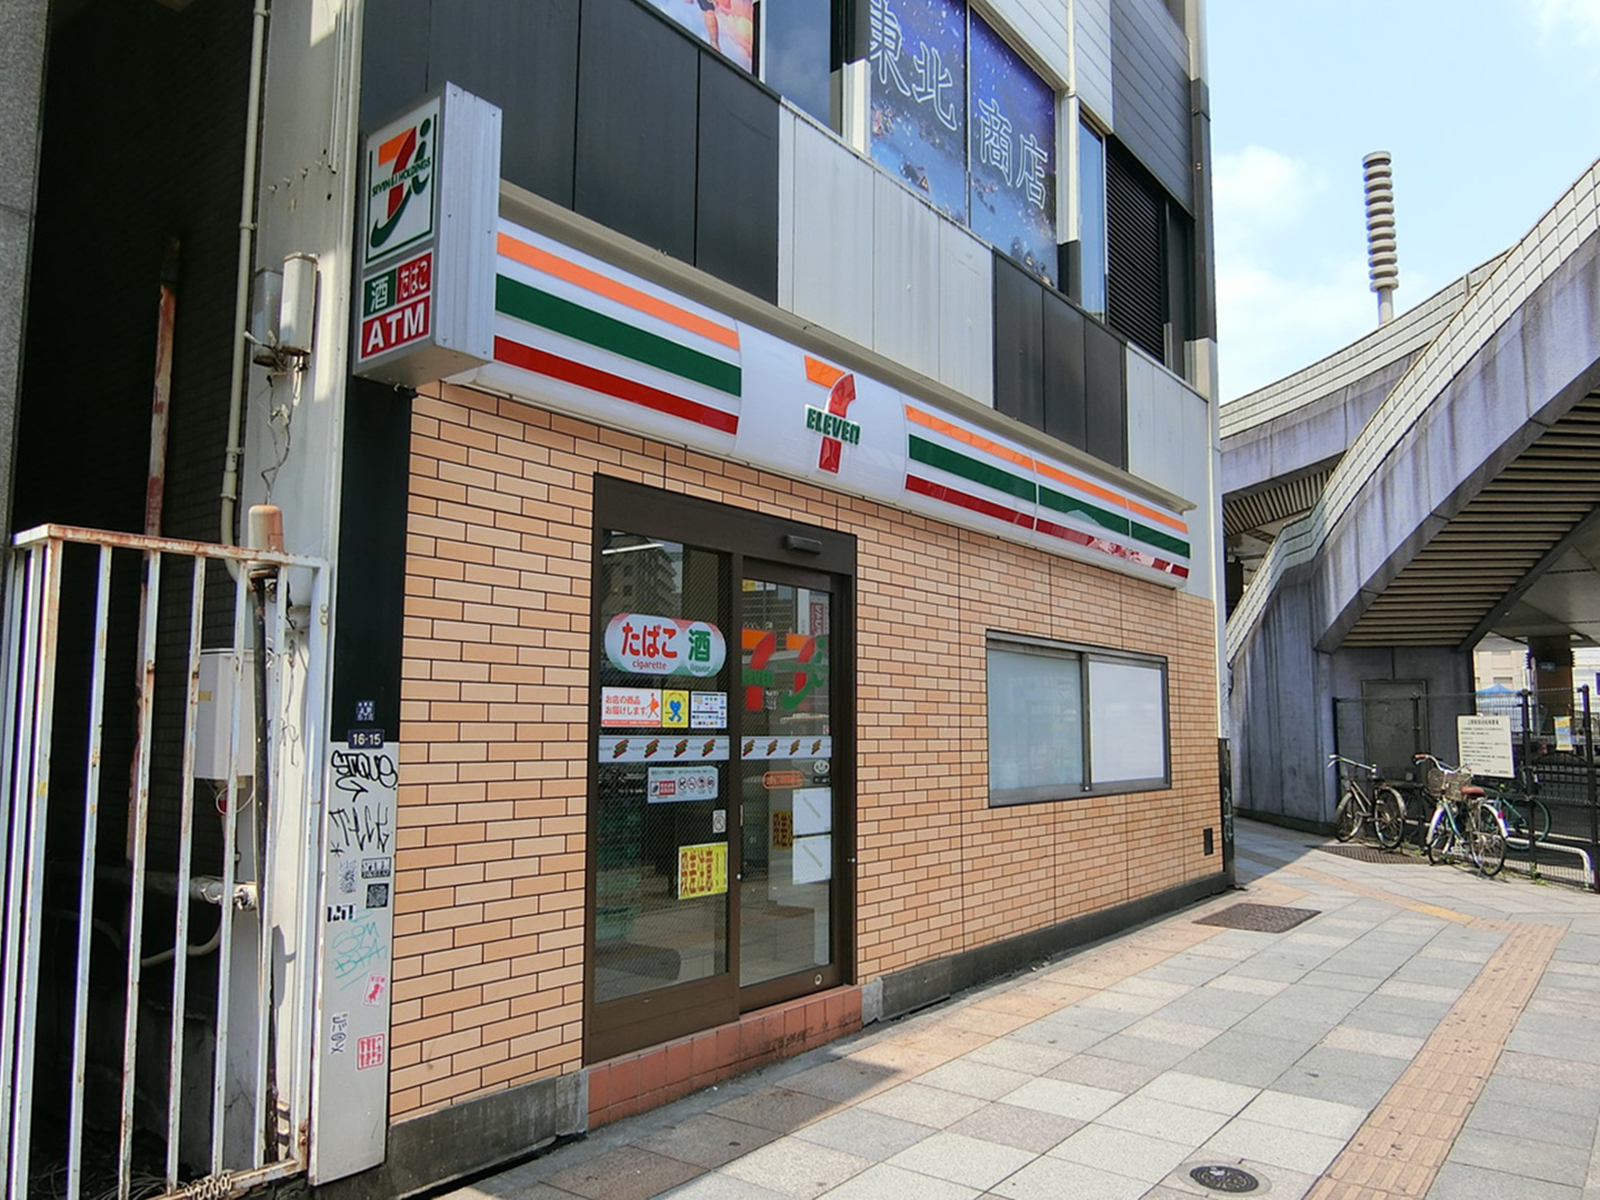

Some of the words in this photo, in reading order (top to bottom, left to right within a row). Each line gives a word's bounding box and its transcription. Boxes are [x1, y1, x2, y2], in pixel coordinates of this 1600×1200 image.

[369, 276, 389, 312] 酒
[400, 261, 428, 299] たばこ
[366, 302, 425, 354] ATM
[621, 622, 678, 659] たばこ
[688, 628, 711, 662] 酒
[631, 659, 668, 671] cigarette
[352, 733, 382, 746] 16-15
